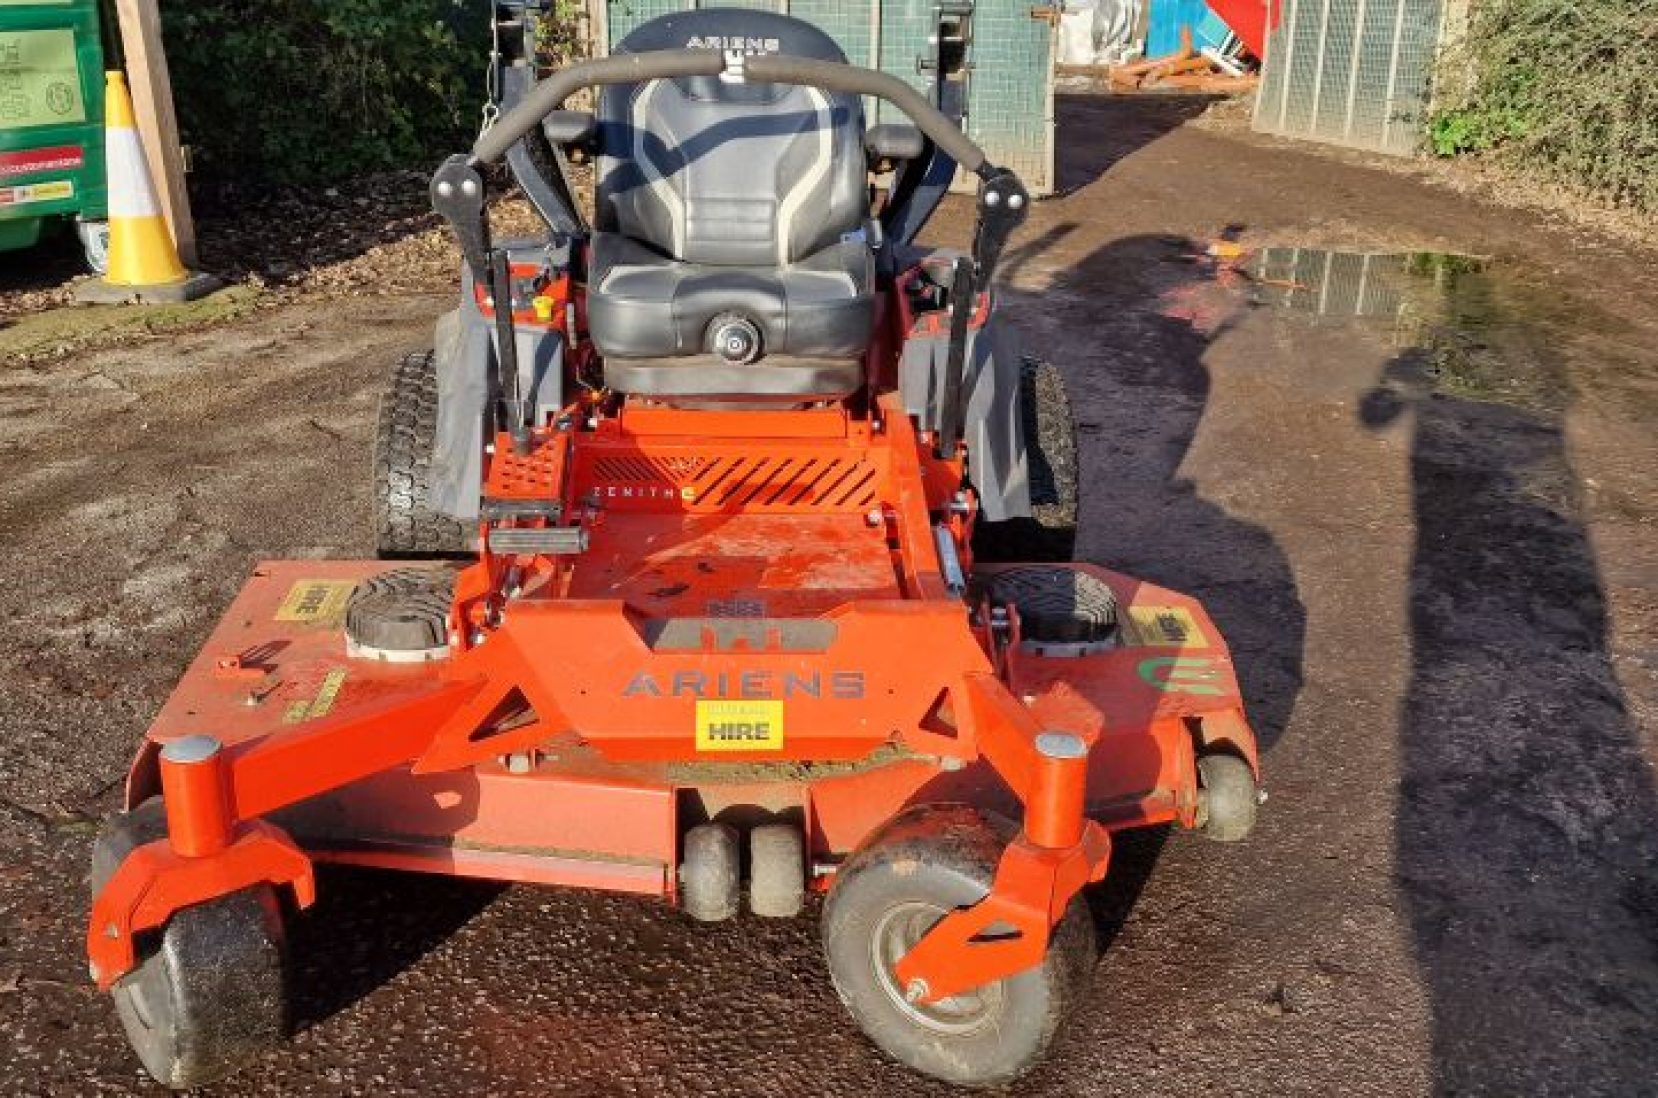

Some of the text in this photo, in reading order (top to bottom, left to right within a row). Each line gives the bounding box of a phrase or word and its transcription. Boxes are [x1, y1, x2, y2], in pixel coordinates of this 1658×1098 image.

[686, 36, 780, 51] ARIENS
[592, 486, 674, 498] ZENITH
[623, 671, 865, 699] ARIENS
[708, 723, 770, 741] HIRE
